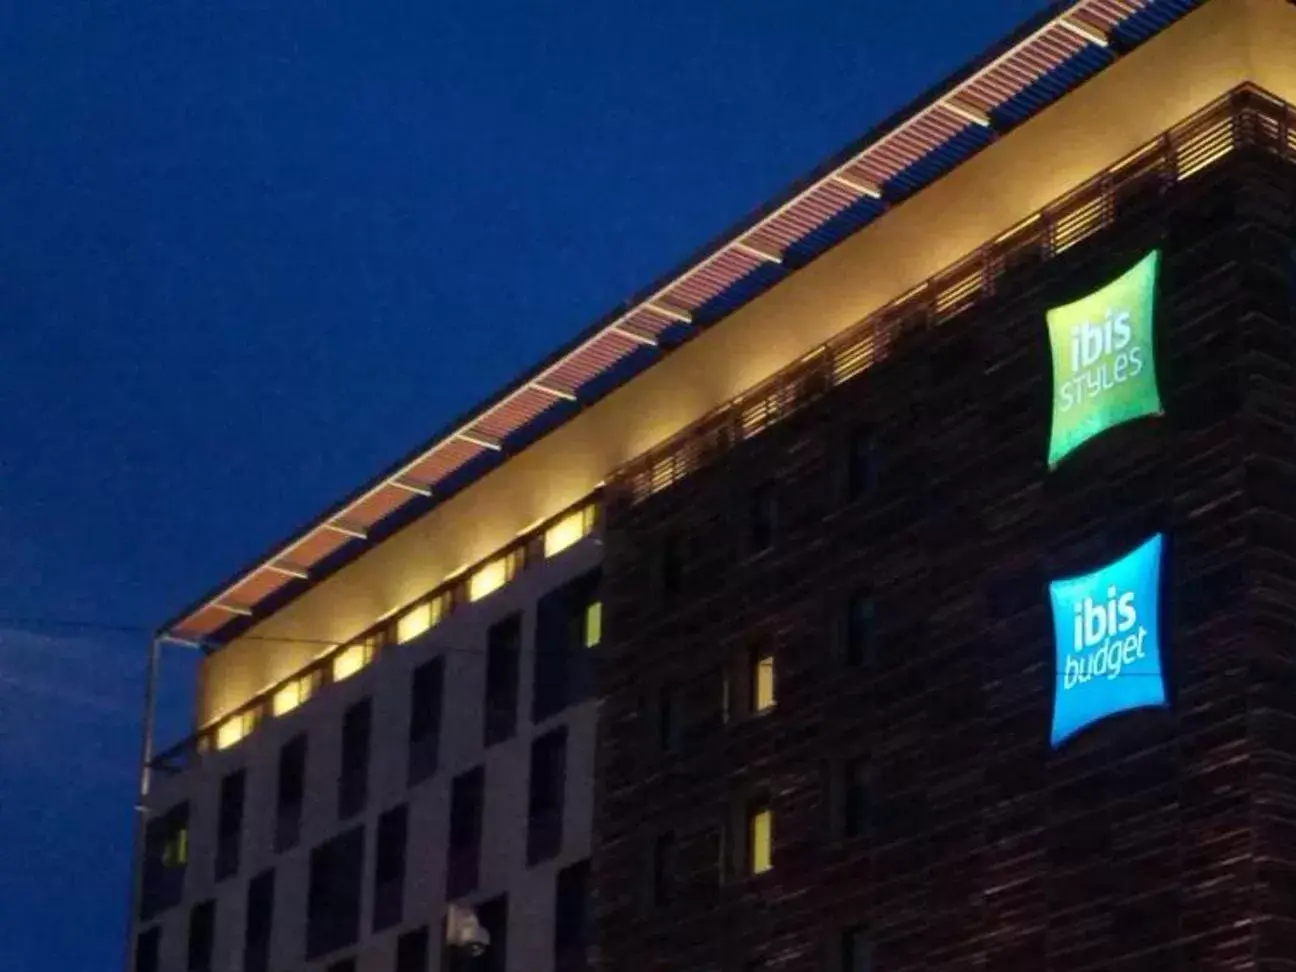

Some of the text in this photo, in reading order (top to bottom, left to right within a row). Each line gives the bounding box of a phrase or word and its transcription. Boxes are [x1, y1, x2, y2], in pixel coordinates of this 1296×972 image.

[1070, 307, 1131, 372] ibis
[1074, 584, 1136, 652] ibis
[1064, 625, 1147, 690] budget
